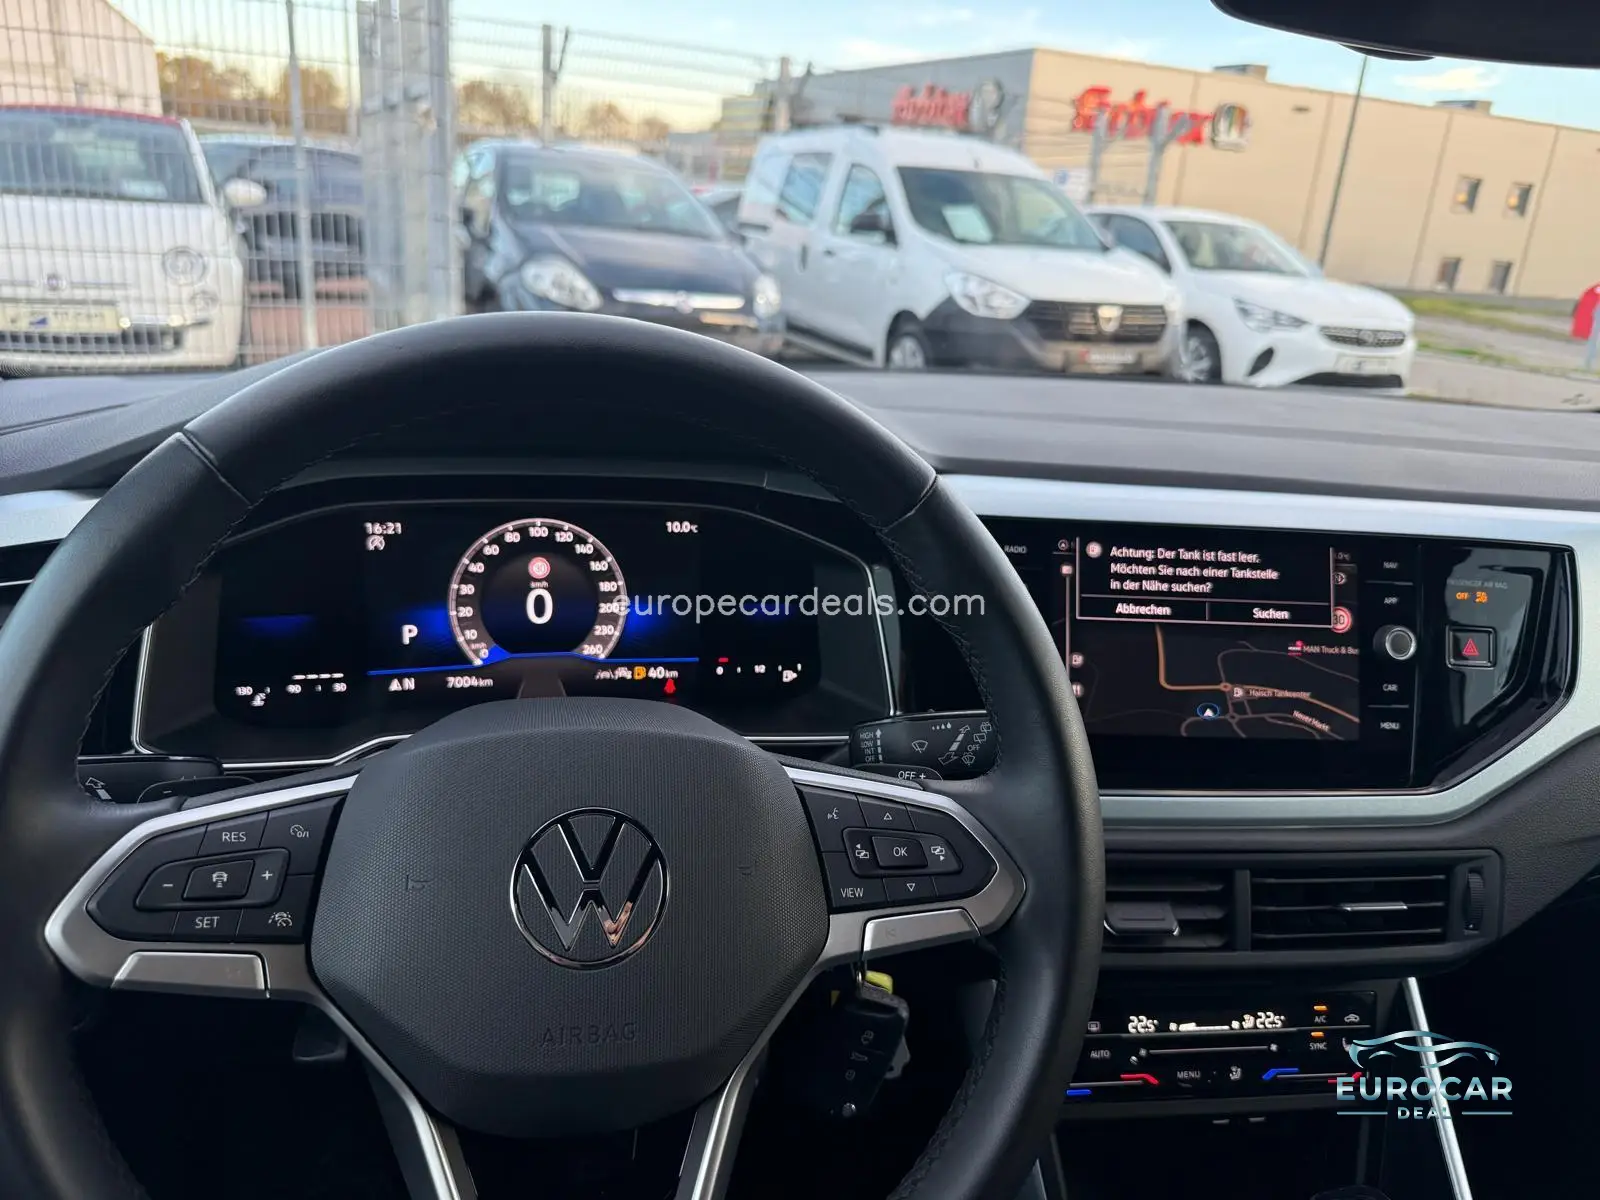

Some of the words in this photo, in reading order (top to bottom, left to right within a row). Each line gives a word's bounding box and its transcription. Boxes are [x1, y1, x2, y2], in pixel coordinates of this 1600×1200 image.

[364, 522, 402, 535] 16:21
[529, 527, 548, 537] 100
[504, 533, 520, 542] 80
[555, 533, 573, 542] 120
[483, 545, 500, 555] 60
[575, 544, 594, 554] 140
[1004, 546, 1027, 554] RADIO
[1110, 546, 1155, 560] Achtung:
[1157, 548, 1175, 559] Der
[1178, 549, 1200, 560] Tank
[1202, 549, 1215, 561] ist
[1217, 550, 1237, 562] fast
[1238, 550, 1261, 563] leer.
[468, 563, 484, 572] 40
[590, 561, 608, 571] 160
[1383, 561, 1398, 569] NAV
[1110, 563, 1157, 576] Möchten
[1158, 564, 1174, 577] Sie
[1175, 565, 1200, 577] nach
[1202, 566, 1228, 578] einer
[1230, 567, 1279, 580] Tankstelle
[460, 584, 475, 595] 30
[599, 582, 617, 592] 180
[1110, 579, 1121, 590] in
[1122, 580, 1140, 591] der
[1142, 580, 1169, 592] Nähe
[1171, 582, 1212, 594] suchen?
[526, 589, 553, 624] 0
[599, 603, 620, 613] 200
[1115, 603, 1172, 616] Abbrechen
[458, 607, 473, 617] 20
[1252, 608, 1289, 620] Suchen
[402, 625, 418, 645] P
[464, 629, 477, 640] 10
[594, 625, 614, 635] 230
[479, 649, 489, 658] 0
[583, 645, 603, 654] 260
[1303, 645, 1320, 653] MAN
[1321, 646, 1339, 654] Truck
[1382, 684, 1398, 692] CAR
[1380, 722, 1400, 730] MENU
[860, 740, 874, 748] LOW
[967, 744, 981, 752] OFF
[898, 771, 916, 780] OFF
[222, 831, 247, 842] RES
[893, 847, 908, 857] OK
[840, 888, 864, 898] VIEW
[195, 917, 220, 928] SET
[1314, 1015, 1327, 1023] A/C
[541, 1022, 637, 1046] AIRBAG
[1309, 1042, 1328, 1051] SYNC
[1090, 1050, 1110, 1058] AUTO
[1177, 1070, 1200, 1079] MENU
